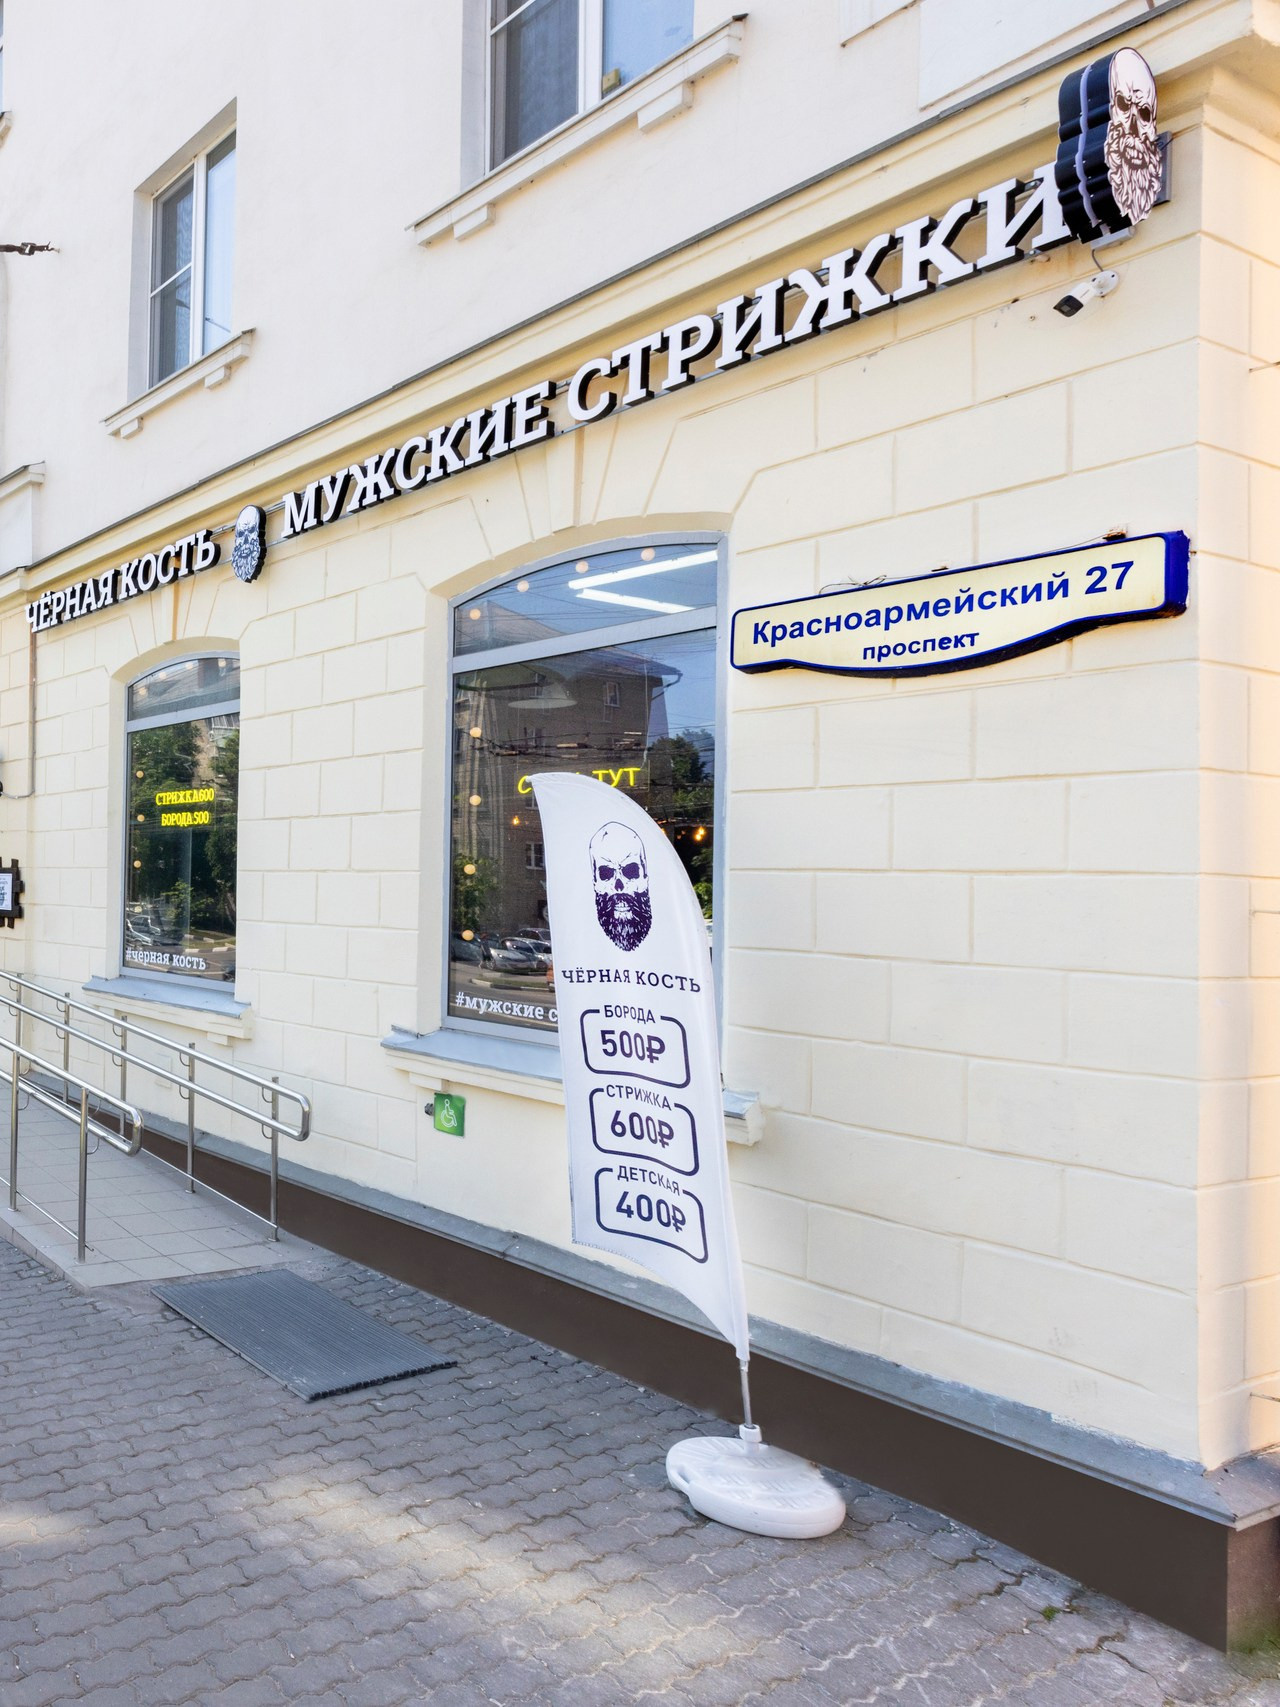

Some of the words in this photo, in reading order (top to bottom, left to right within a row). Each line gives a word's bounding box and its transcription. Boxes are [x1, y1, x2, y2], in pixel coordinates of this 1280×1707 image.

[281, 382, 554, 538] МУЖСКИЕ
[568, 161, 1074, 423] СТРИЖКИ
[24, 568, 117, 633] ЧЁРНАЯ
[119, 529, 218, 598] КОСТЬ
[753, 572, 1070, 647] Красноармейский
[1085, 561, 1135, 594] 27
[863, 632, 980, 662] проспект
[592, 767, 641, 787] ТУТ
[161, 812, 193, 827] БОРОДА
[172, 954, 206, 970] кость
[562, 966, 631, 984] ЧЁРНАЯ
[635, 971, 701, 993] КОСТЬ
[455, 991, 544, 1020] #мужские
[604, 1005, 656, 1024] БОРОДА
[606, 1084, 672, 1111] СТРИЖКА
[617, 1165, 681, 1196] ДЕТСКАЯ
